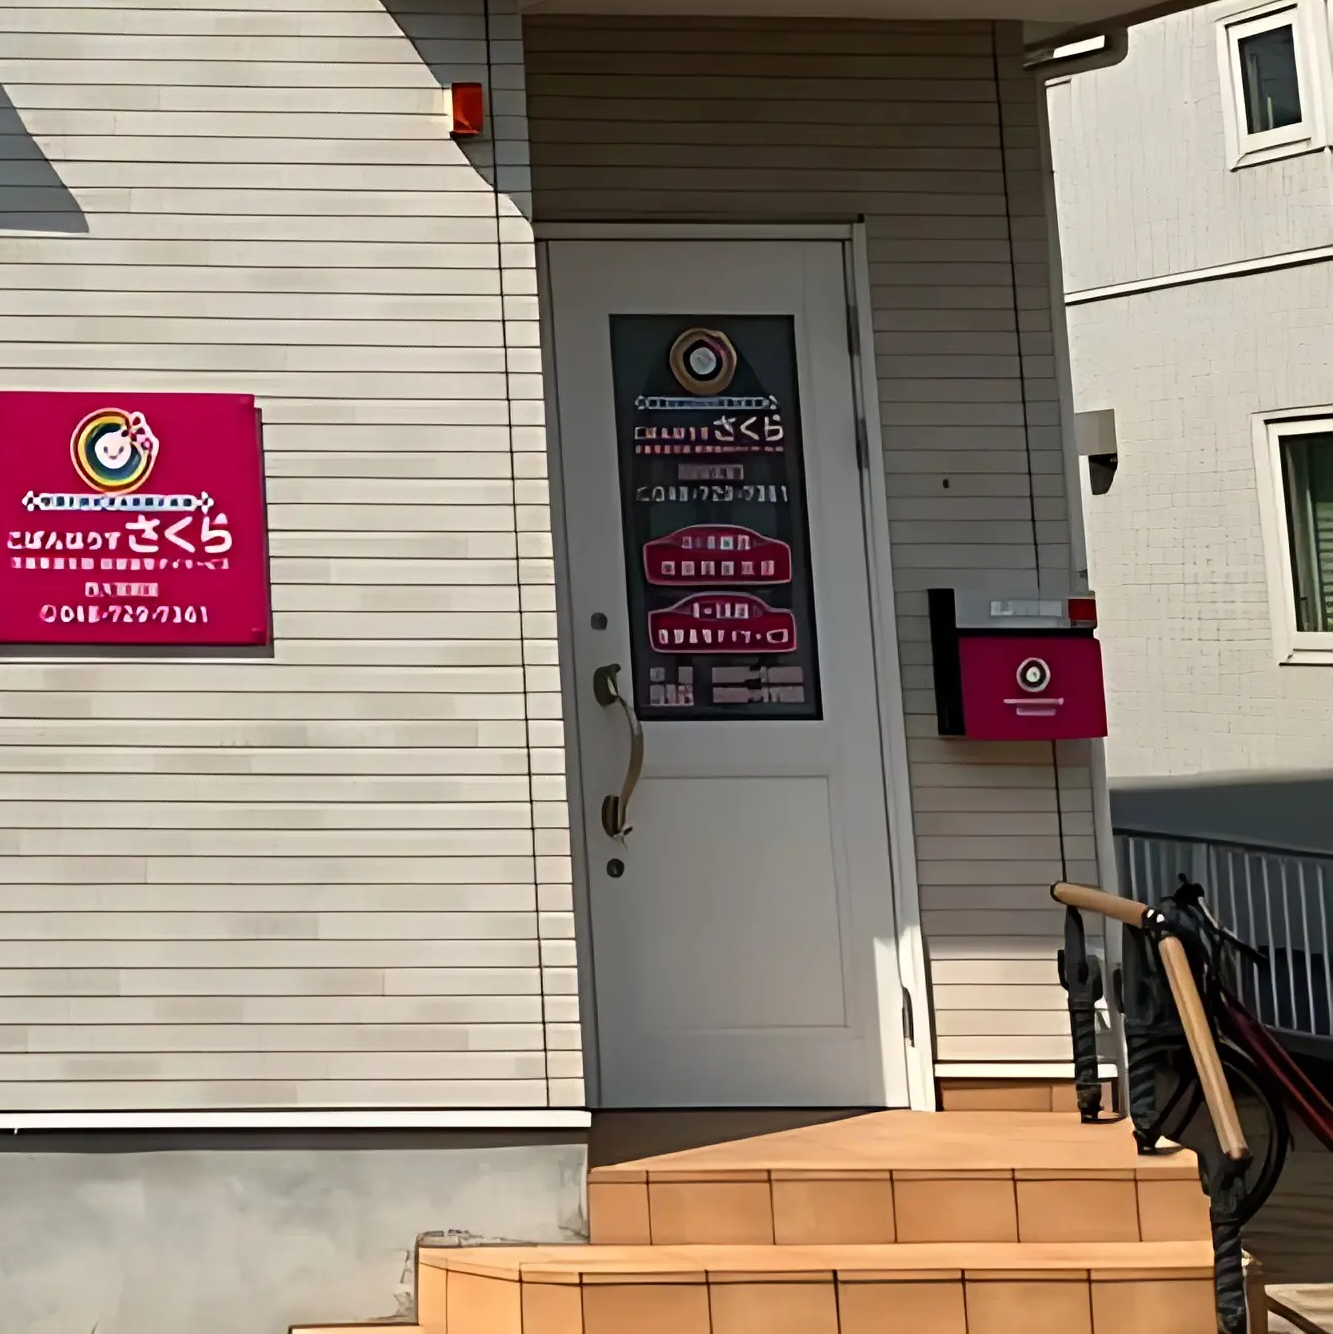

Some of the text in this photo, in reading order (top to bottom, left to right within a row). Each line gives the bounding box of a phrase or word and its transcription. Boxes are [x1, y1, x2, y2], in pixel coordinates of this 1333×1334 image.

[713, 413, 785, 442] さくら
[125, 512, 233, 554] さくら
